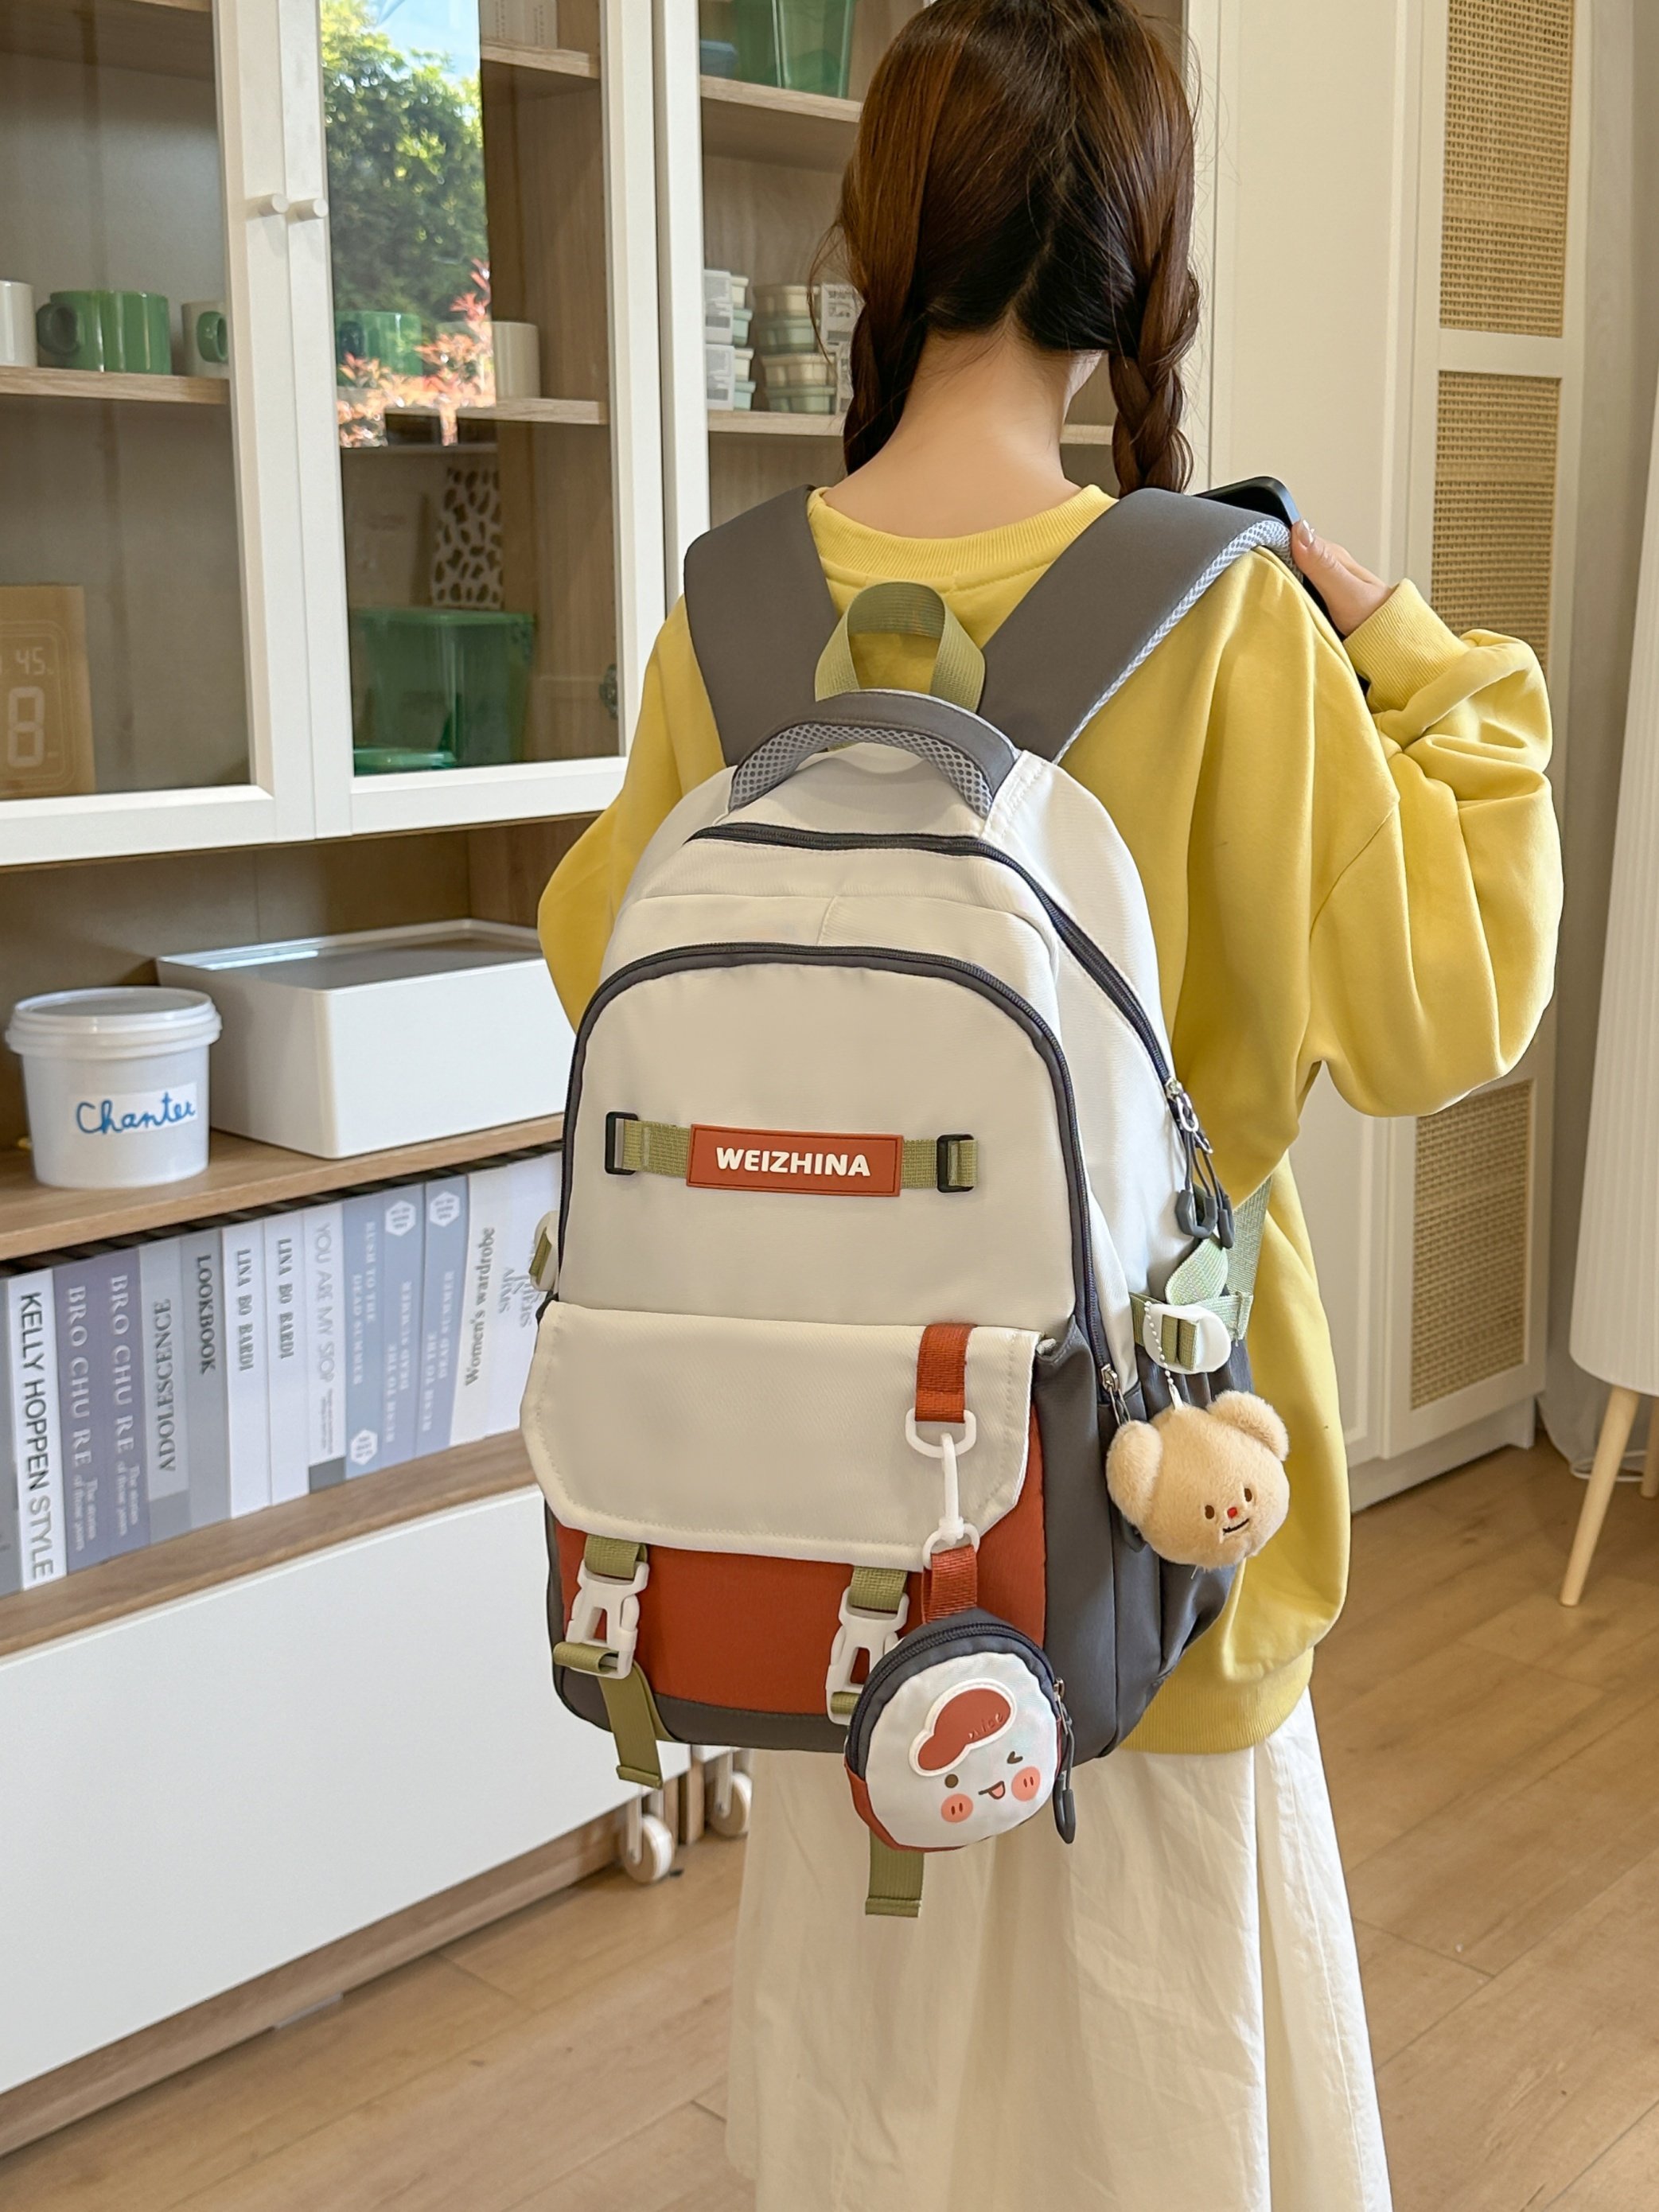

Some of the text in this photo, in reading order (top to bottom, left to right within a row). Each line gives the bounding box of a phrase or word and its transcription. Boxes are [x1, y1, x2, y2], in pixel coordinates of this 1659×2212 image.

[715, 1147, 871, 1177] WEIZHINA
[277, 1237, 294, 1360] LINA BO BARDI
[314, 1221, 333, 1264] YOU
[317, 1269, 333, 1302] ARE
[109, 1275, 134, 1455] BRO CHU RE
[197, 1254, 216, 1375] LOOKBOOK
[237, 1248, 254, 1372] LINA BO BARDI
[317, 1306, 333, 1336] MY
[465, 1226, 496, 1387] Women's wardrobe
[20, 1291, 54, 1581] KELLY HOPPEN STYLE
[67, 1285, 92, 1468] BRO CHU RE
[154, 1298, 177, 1472] ADOLESCENCE
